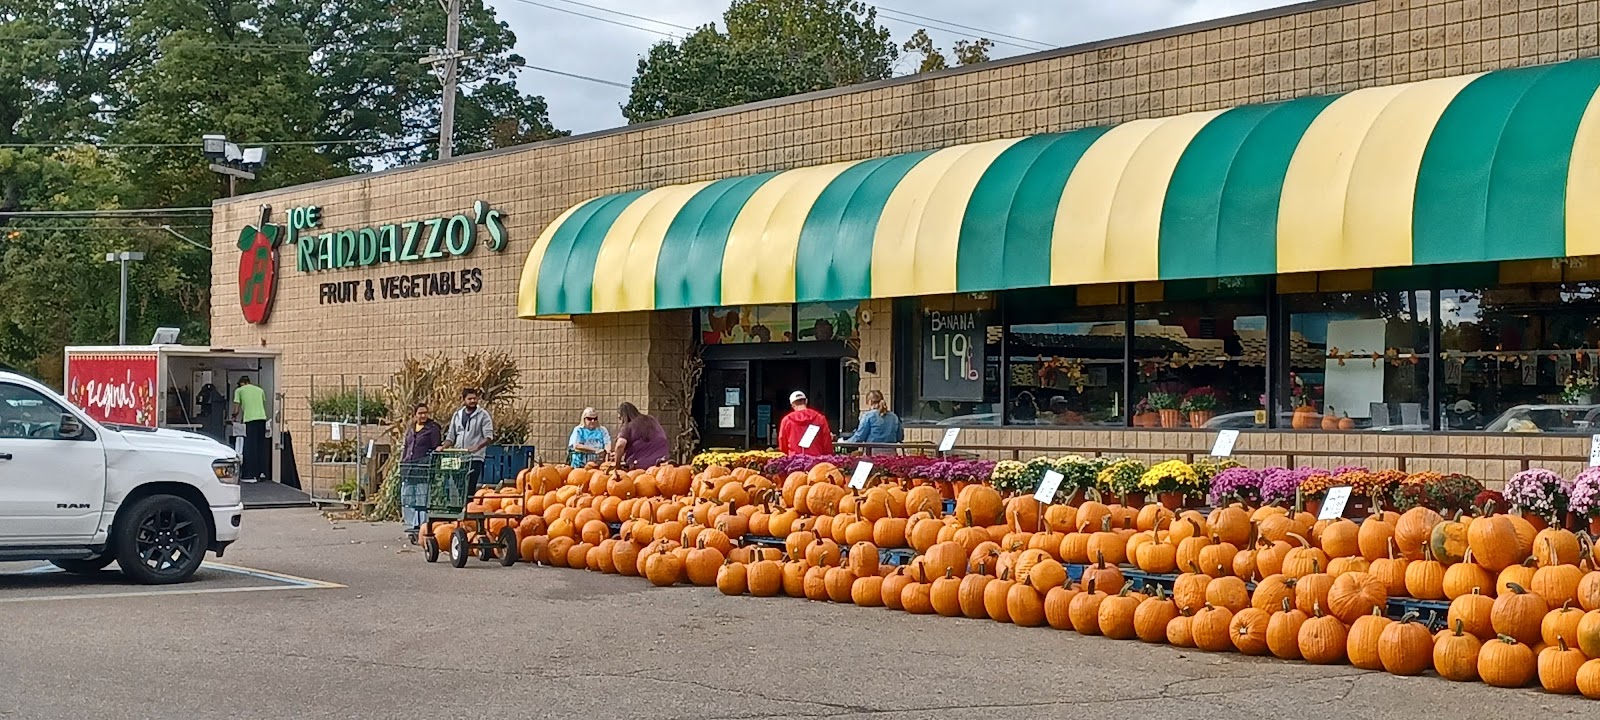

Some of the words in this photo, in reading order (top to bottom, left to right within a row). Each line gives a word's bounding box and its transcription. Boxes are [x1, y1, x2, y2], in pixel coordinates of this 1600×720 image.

[285, 205, 323, 245] JOE
[297, 200, 508, 273] RANDAZZO'S
[319, 280, 360, 305] FRUIT
[364, 278, 375, 301] &
[379, 267, 483, 300] VEGETABLES
[931, 310, 975, 331] BANANA
